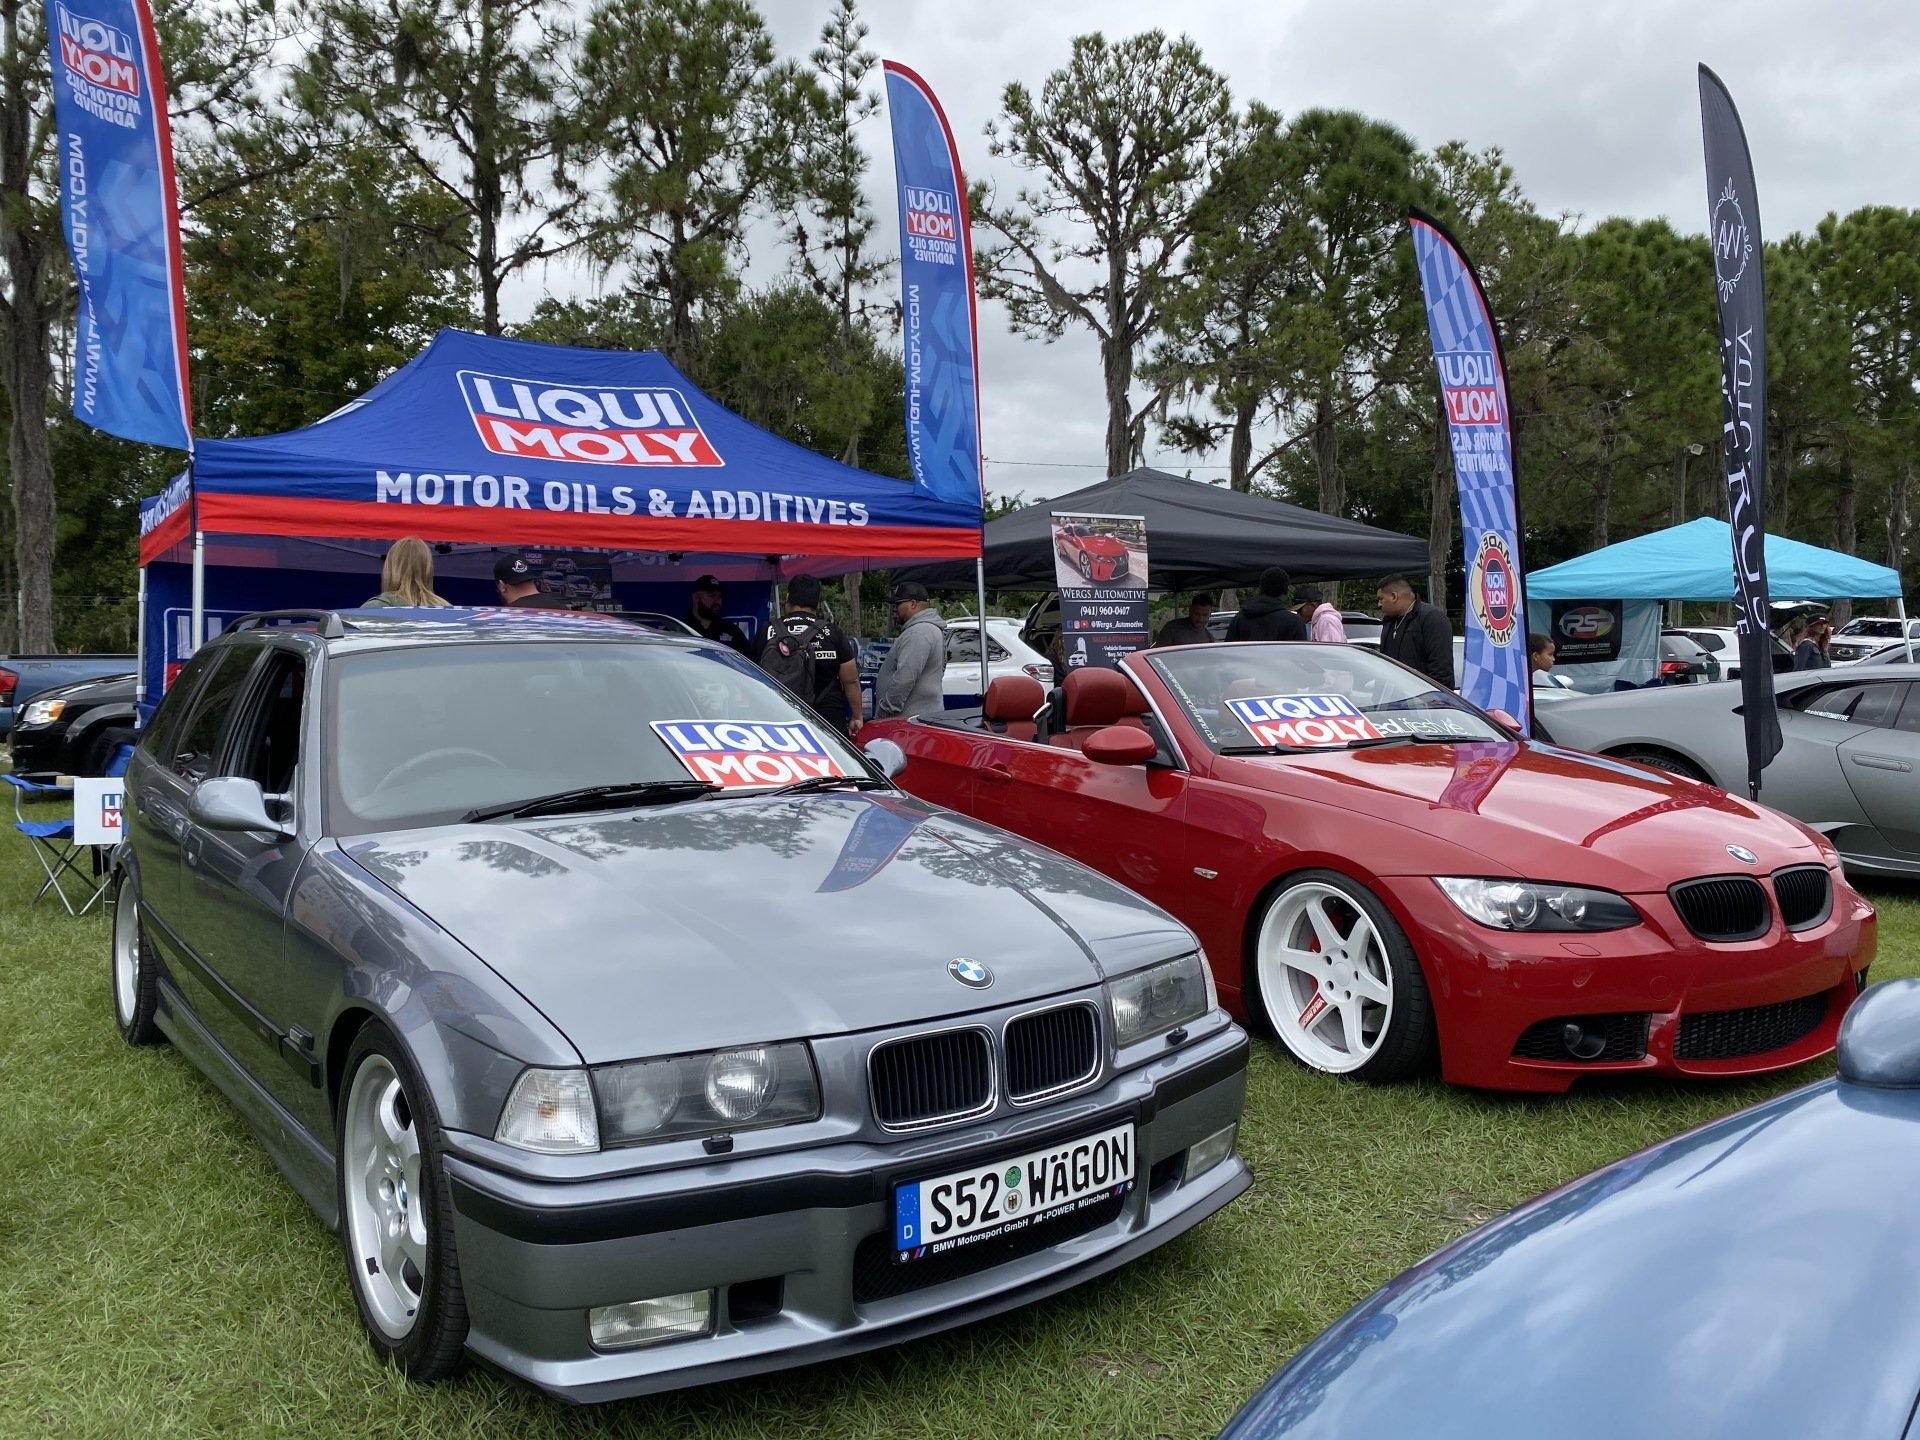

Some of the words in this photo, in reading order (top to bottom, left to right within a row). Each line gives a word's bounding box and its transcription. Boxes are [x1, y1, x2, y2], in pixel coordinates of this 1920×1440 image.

[473, 378, 685, 430] LIQUI
[489, 420, 698, 463] MOLY
[376, 471, 532, 510] MOTOR
[543, 481, 636, 516] OILS
[648, 488, 677, 518] &
[686, 490, 869, 527] ADDITIVES
[1061, 588, 1092, 599] WERGS
[1094, 588, 1146, 599] AUTOMOTIVE
[1236, 695, 1347, 722] LIQUI
[665, 724, 818, 754] LIQUI
[1260, 717, 1376, 745] MOLY
[692, 755, 831, 785] MOLY
[931, 1172, 999, 1235] S52
[1027, 1132, 1129, 1207] WÄGON
[903, 1225, 913, 1240] D
[933, 1239, 956, 1254] BMW
[957, 1226, 1002, 1247] Motorsport
[1004, 1217, 1029, 1234] GmbH
[1078, 1191, 1110, 1209] München
